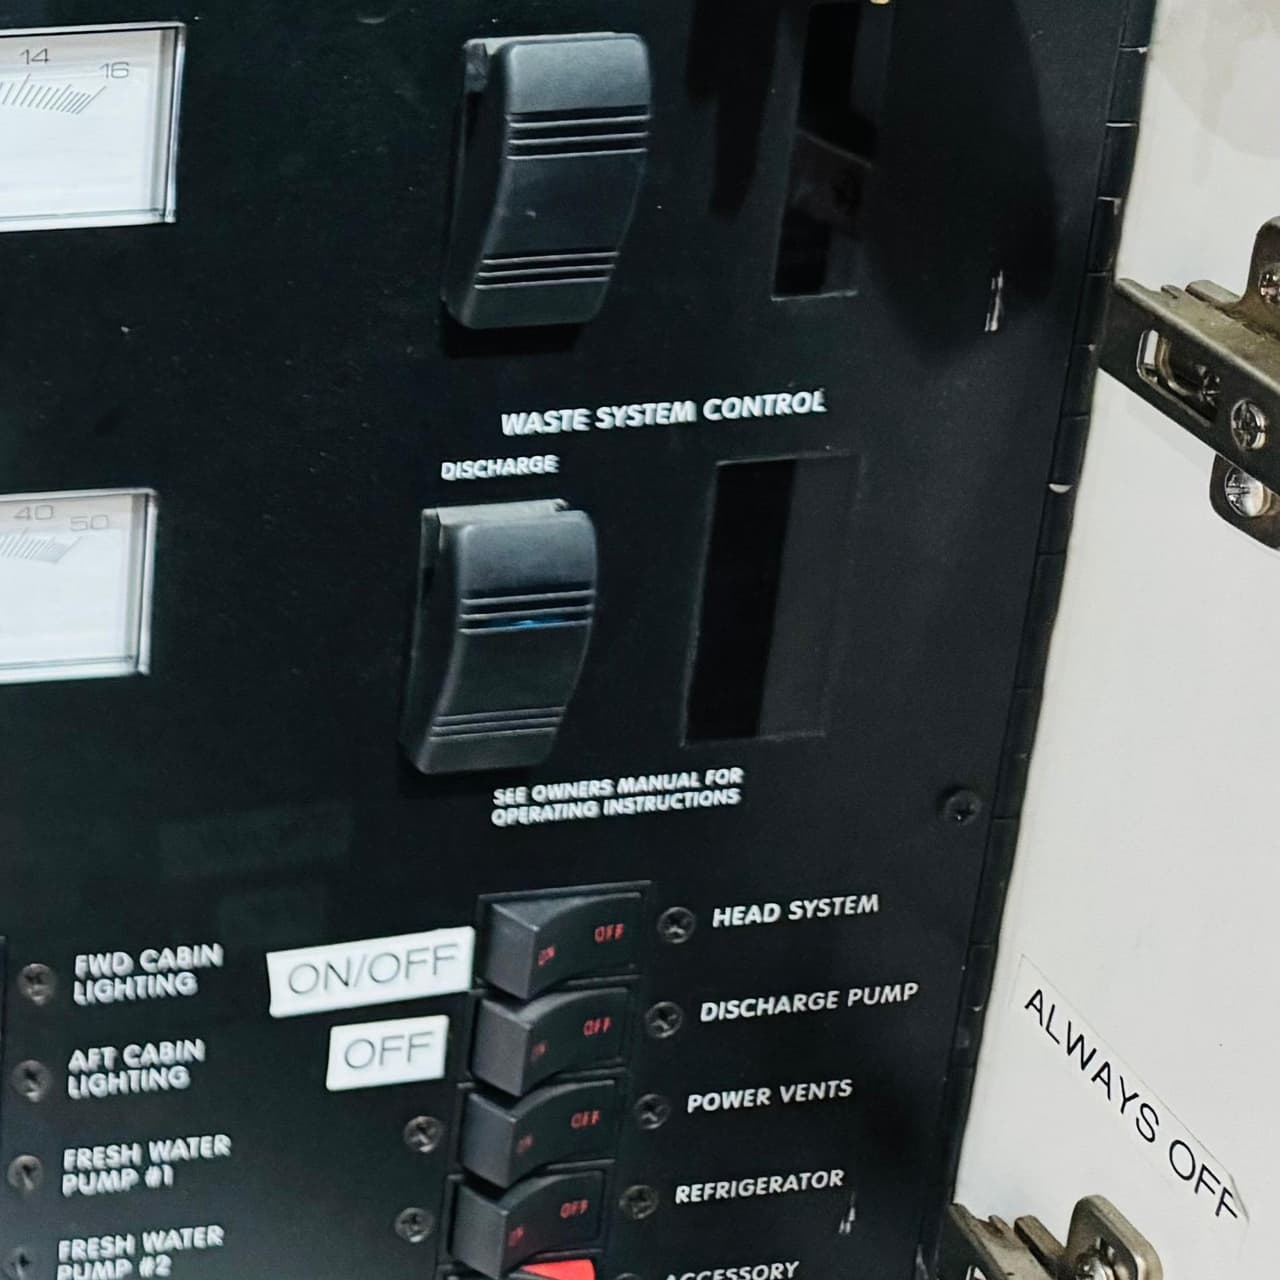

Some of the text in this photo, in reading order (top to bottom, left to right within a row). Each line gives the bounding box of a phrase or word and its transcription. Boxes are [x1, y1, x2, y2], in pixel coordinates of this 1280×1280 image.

[20, 49, 50, 65] 14
[502, 390, 827, 436] WASTE SYSTEM CONTROL
[442, 455, 558, 481] DISCHARGE
[493, 767, 743, 806] SEE OWNERS MANUAL FOR
[491, 788, 741, 827] OPERATING INSTRUCTIONS
[712, 894, 879, 928] HEAD SYSTEM
[75, 943, 223, 978] FWD CABIN
[287, 942, 460, 995] ON/OFF
[74, 972, 198, 1006] LIGHTING
[700, 982, 918, 1022] DISCHARGE PUMP
[68, 1038, 205, 1072] AFT CABIN
[343, 1031, 436, 1071] OFF
[68, 1066, 190, 1100] LIGHTING
[687, 1079, 852, 1113] POWER VENTS
[1025, 989, 1237, 1218] ALWAYS OFF
[64, 1134, 232, 1172] FRESH WATER
[62, 1164, 173, 1197] PUMP #1
[675, 1168, 844, 1204] REFRIGERATOR
[58, 1225, 224, 1262] FRESH WATER
[56, 1254, 171, 1280] PUMP #2
[665, 1260, 799, 1280] CESSORY
